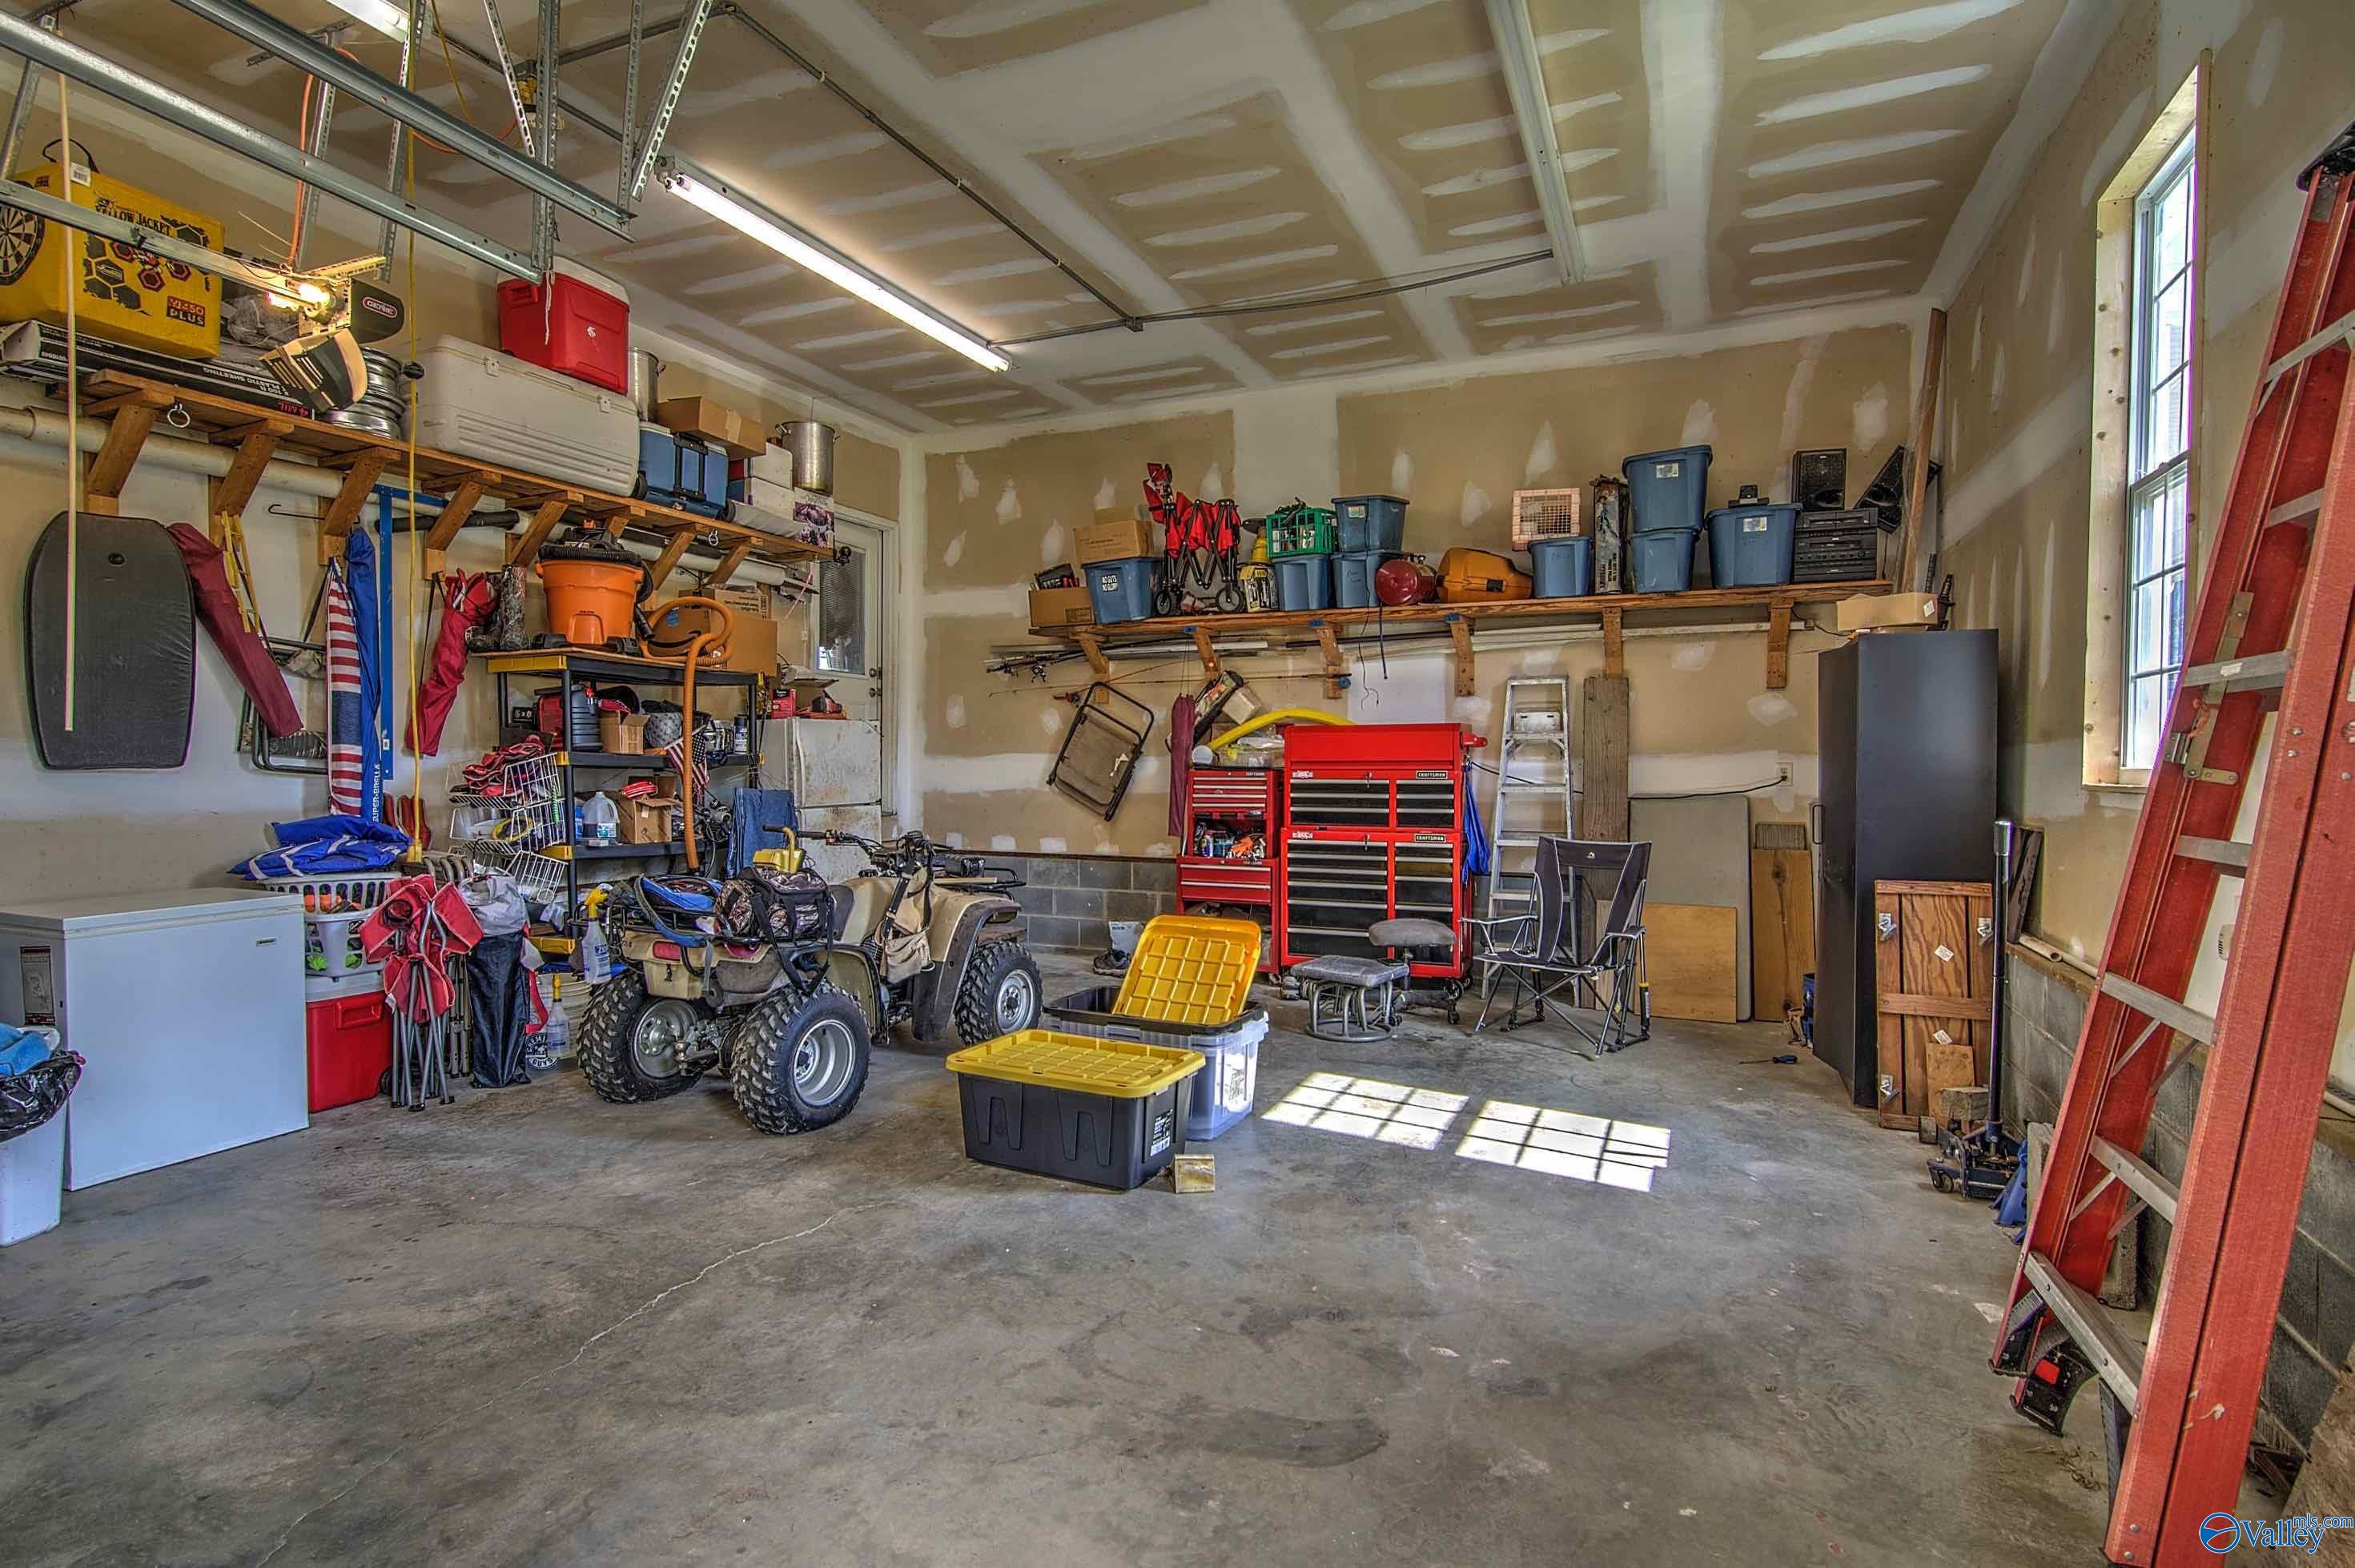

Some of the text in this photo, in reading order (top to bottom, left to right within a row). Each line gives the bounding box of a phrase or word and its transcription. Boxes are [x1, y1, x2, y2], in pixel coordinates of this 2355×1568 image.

[94, 204, 171, 235] YELLOW JACKET
[170, 308, 204, 324] PLUS
